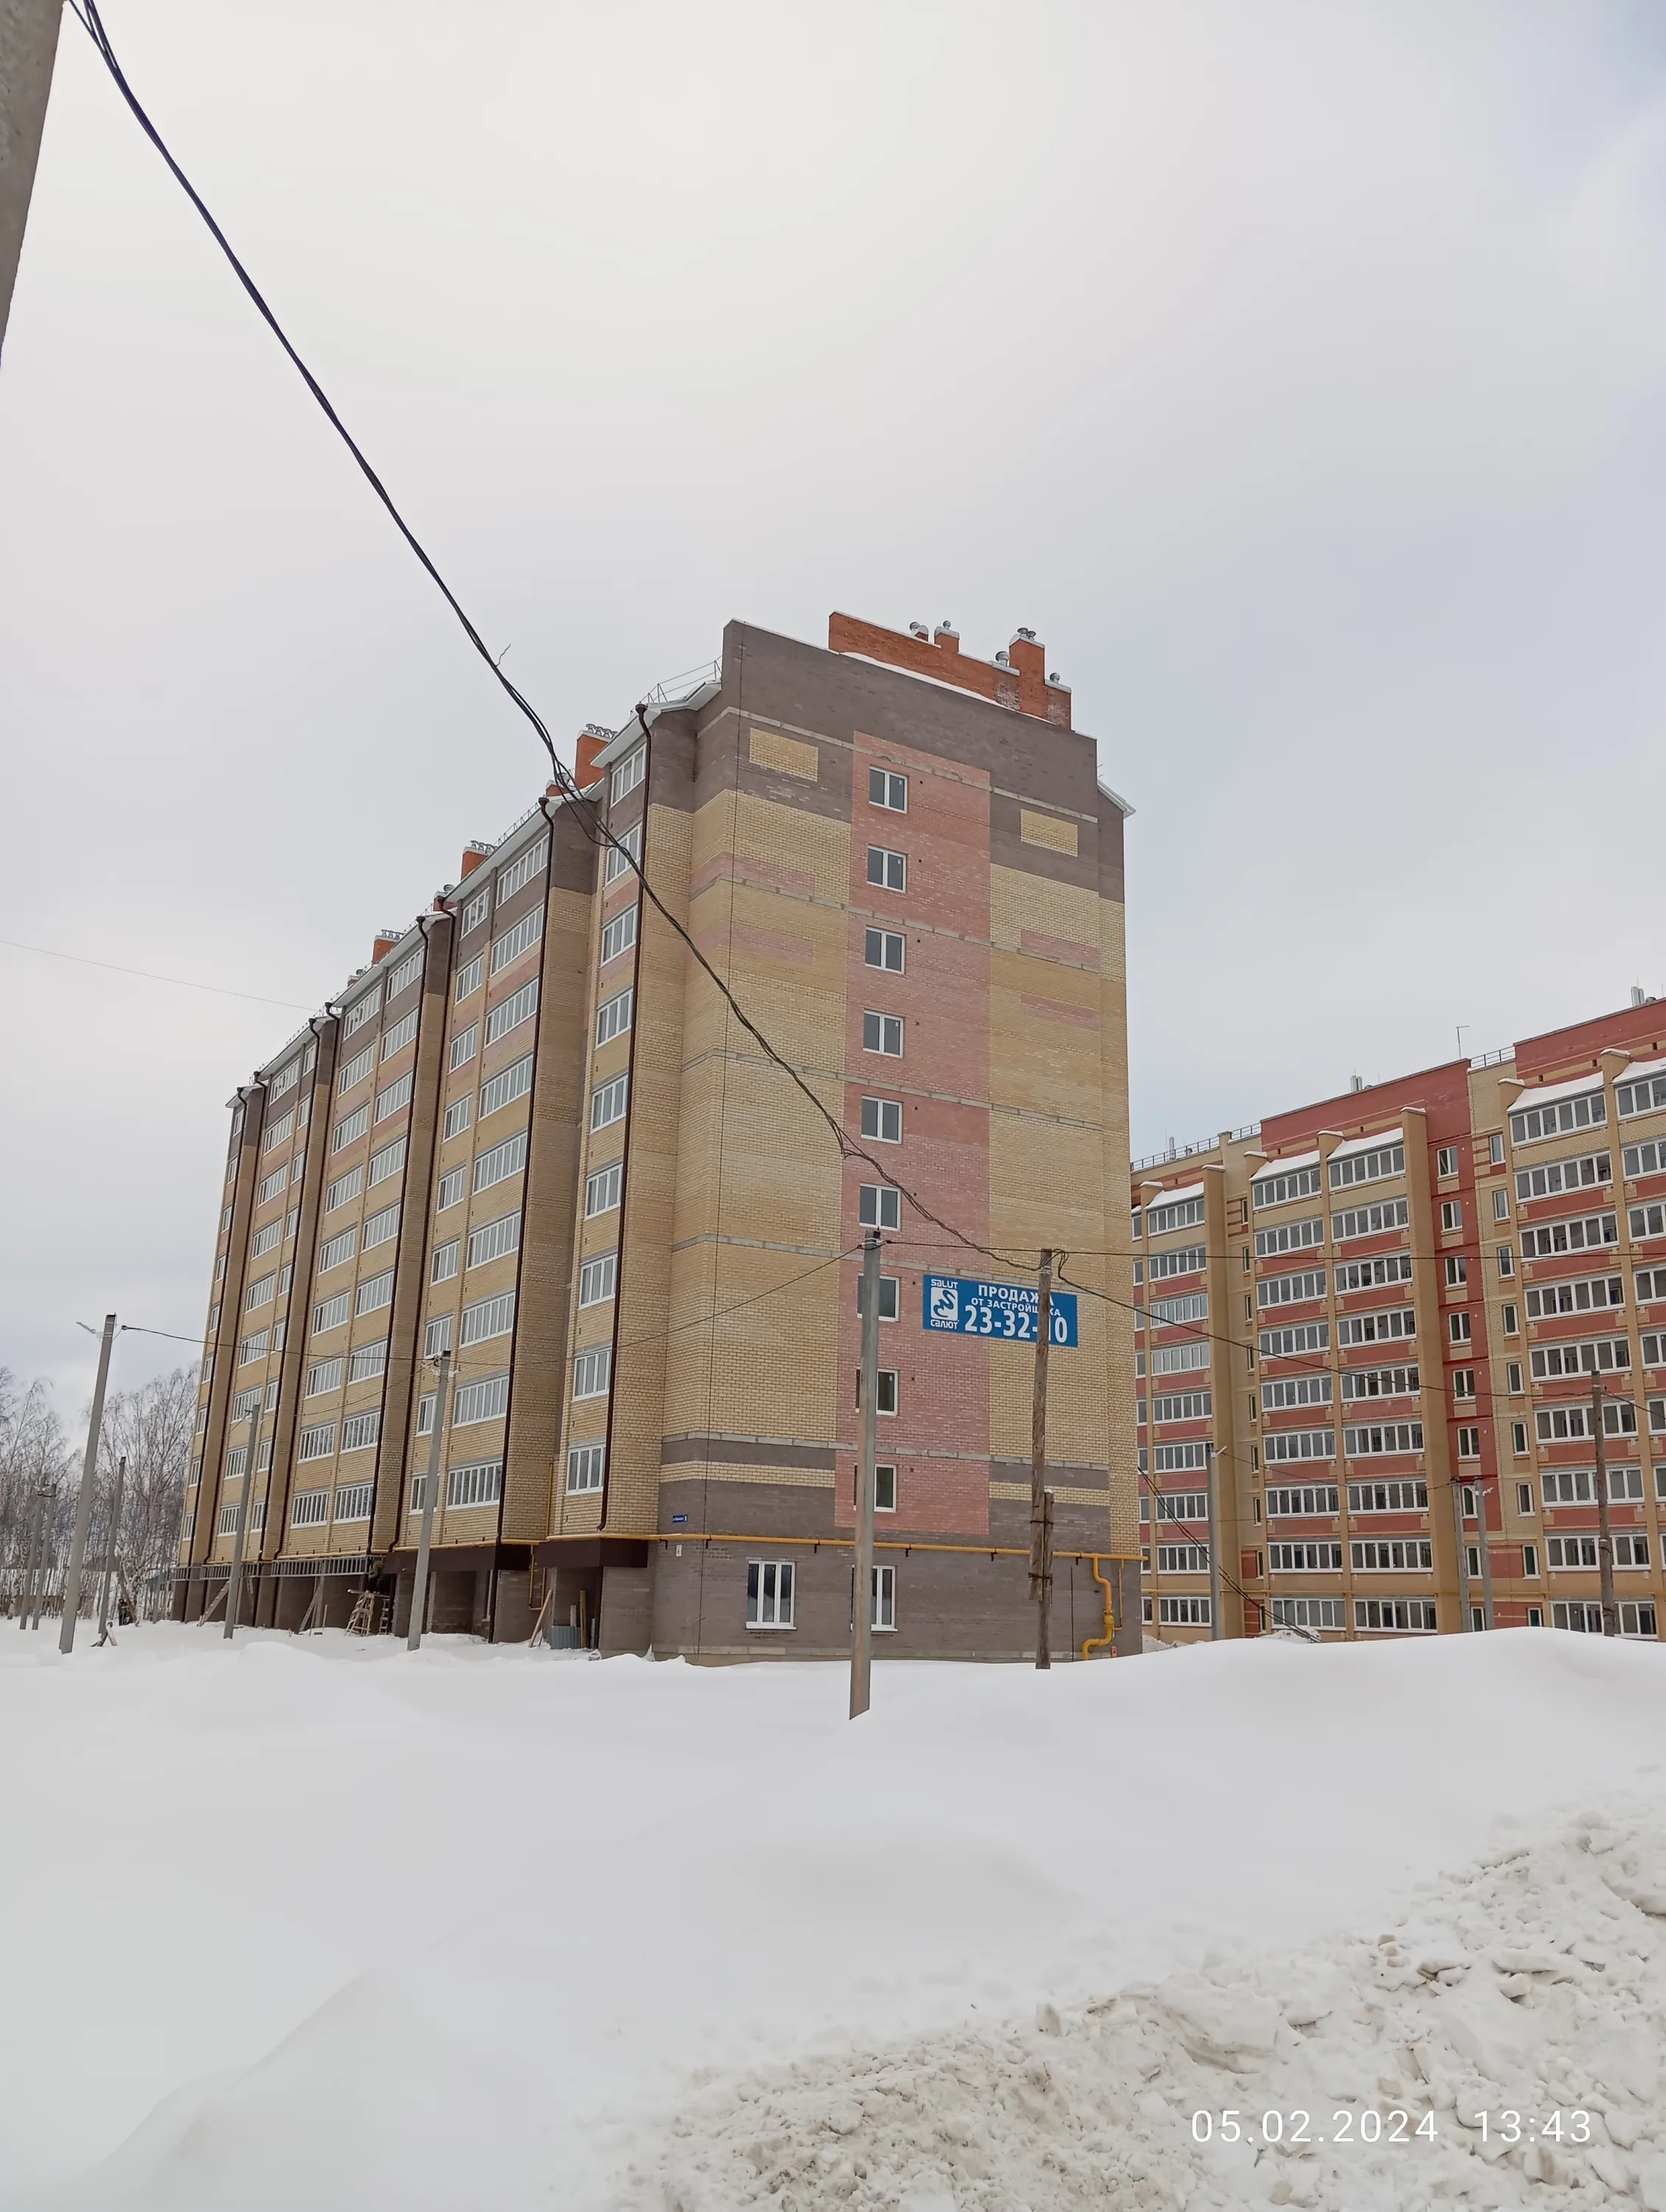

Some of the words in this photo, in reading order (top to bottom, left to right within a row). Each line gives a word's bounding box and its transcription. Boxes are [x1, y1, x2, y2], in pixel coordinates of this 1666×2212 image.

[971, 1298, 984, 1306] ОТ
[987, 1299, 1061, 1316] ЗАСТРОЙЩКА
[965, 1304, 1068, 1343] 23-32-0
